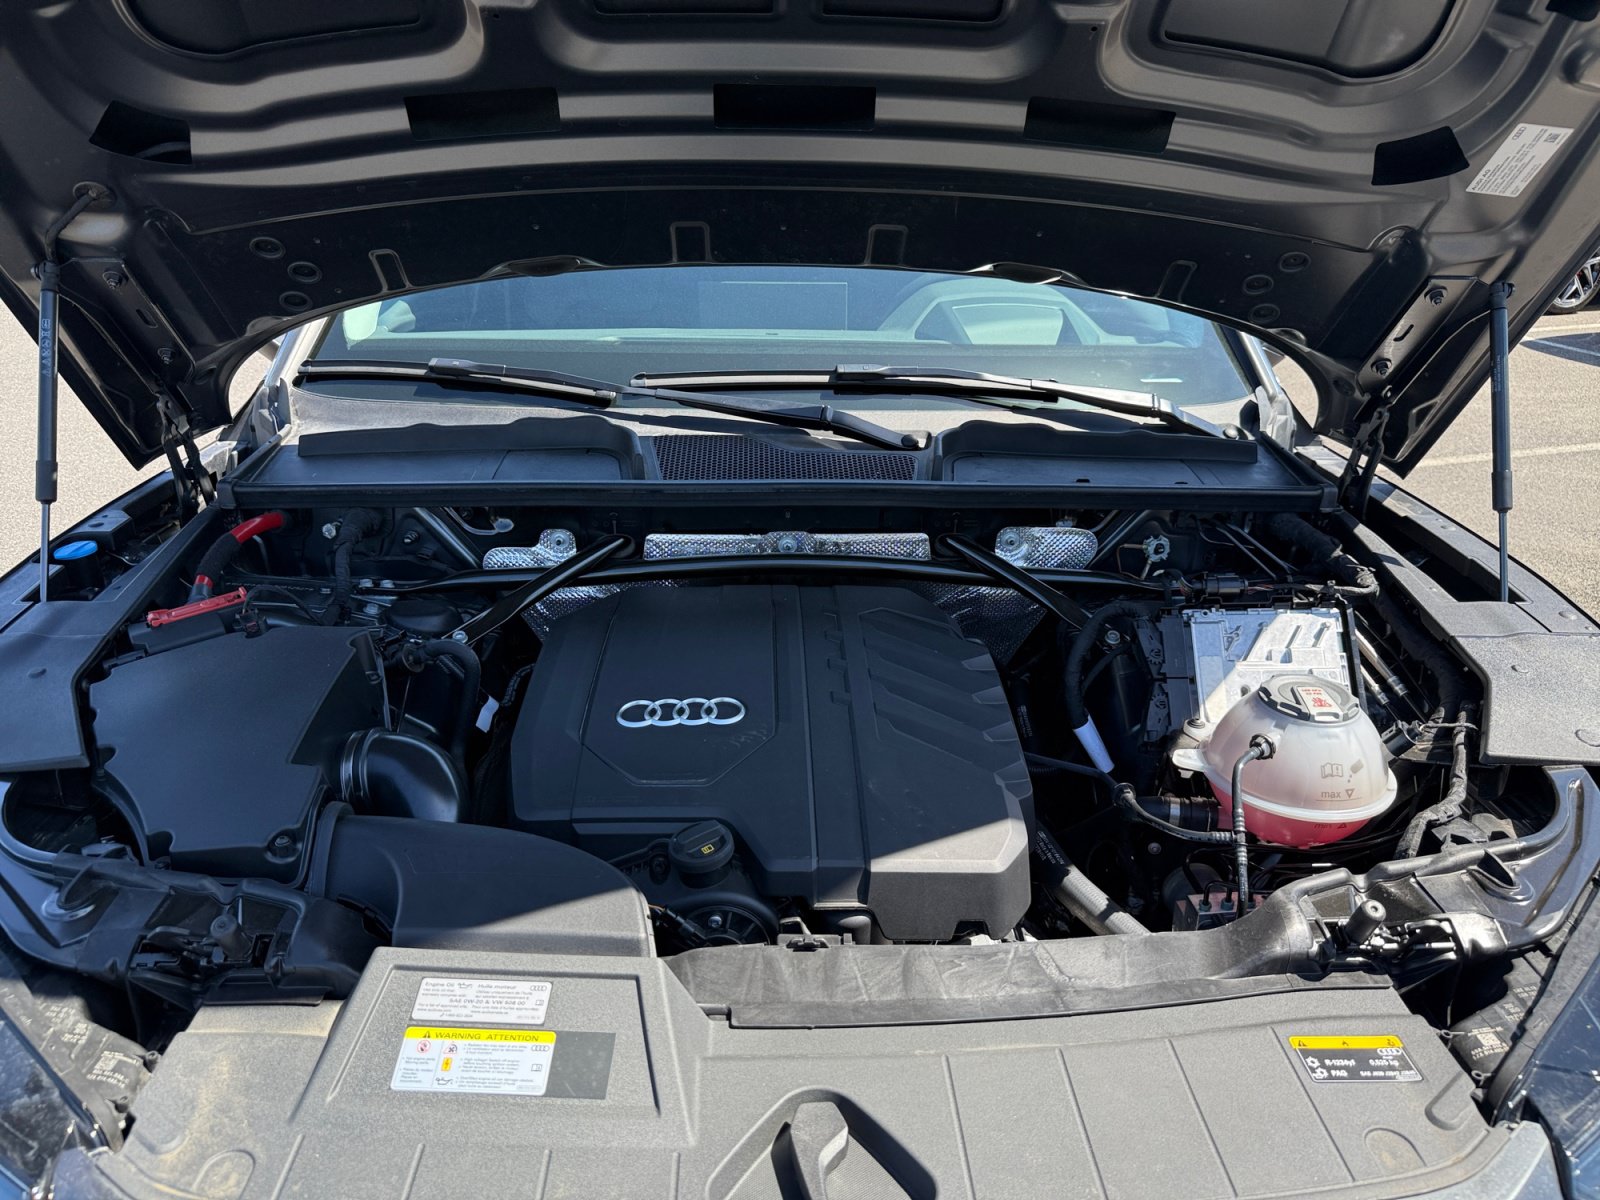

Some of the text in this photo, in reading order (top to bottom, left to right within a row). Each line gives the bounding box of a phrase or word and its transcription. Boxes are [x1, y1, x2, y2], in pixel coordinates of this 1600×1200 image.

[1321, 791, 1341, 799] max
[435, 1032, 540, 1042] WARNING ATTENTION
